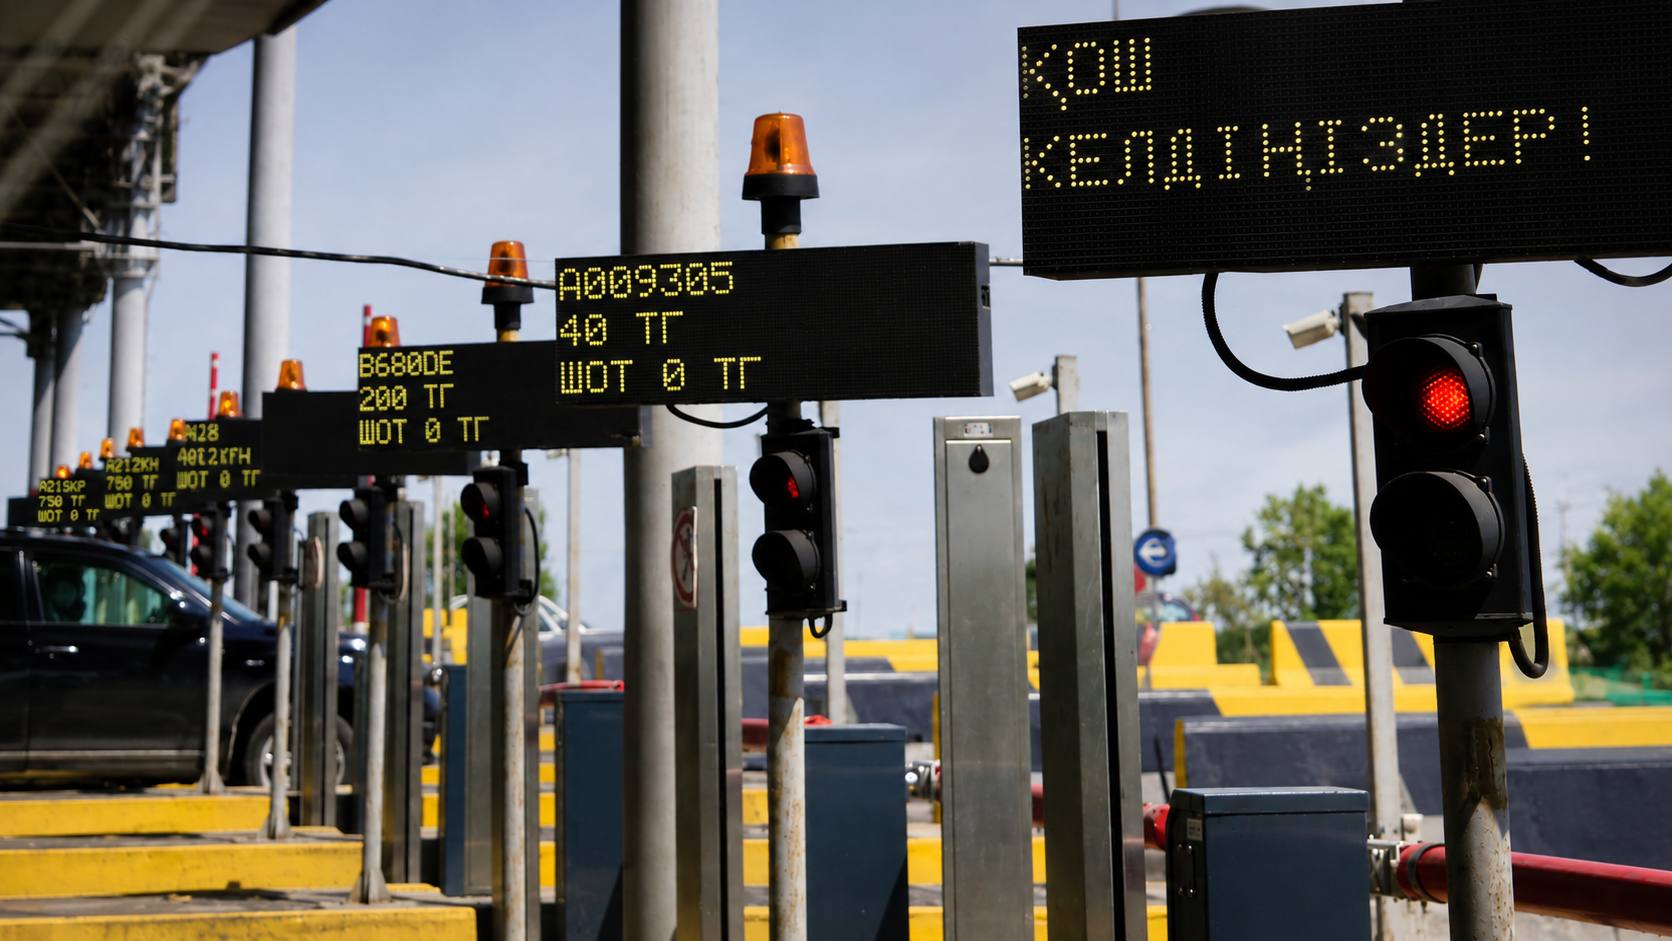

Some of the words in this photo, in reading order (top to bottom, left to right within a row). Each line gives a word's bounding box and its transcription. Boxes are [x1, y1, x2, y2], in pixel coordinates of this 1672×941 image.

[1022, 37, 1153, 112] ҚОШ
[1024, 105, 1592, 191] КЕЛДІҢІЗДЕР!
[558, 260, 735, 301] A009305
[559, 312, 608, 346] 40
[635, 310, 685, 345] ТГ
[358, 349, 455, 378] B680DE
[560, 358, 635, 394] ШОТ
[662, 358, 686, 392] 0
[712, 355, 762, 390] ТГ
[359, 385, 407, 412] 200
[423, 383, 455, 410] ТГ
[359, 418, 407, 445] ШОТ
[425, 417, 441, 443] 0
[457, 416, 490, 442] ТГ
[176, 470, 209, 490] ШОТ
[242, 469, 261, 487] ТГ
[37, 509, 63, 522] ШОТ
[104, 493, 133, 510] ШОТ
